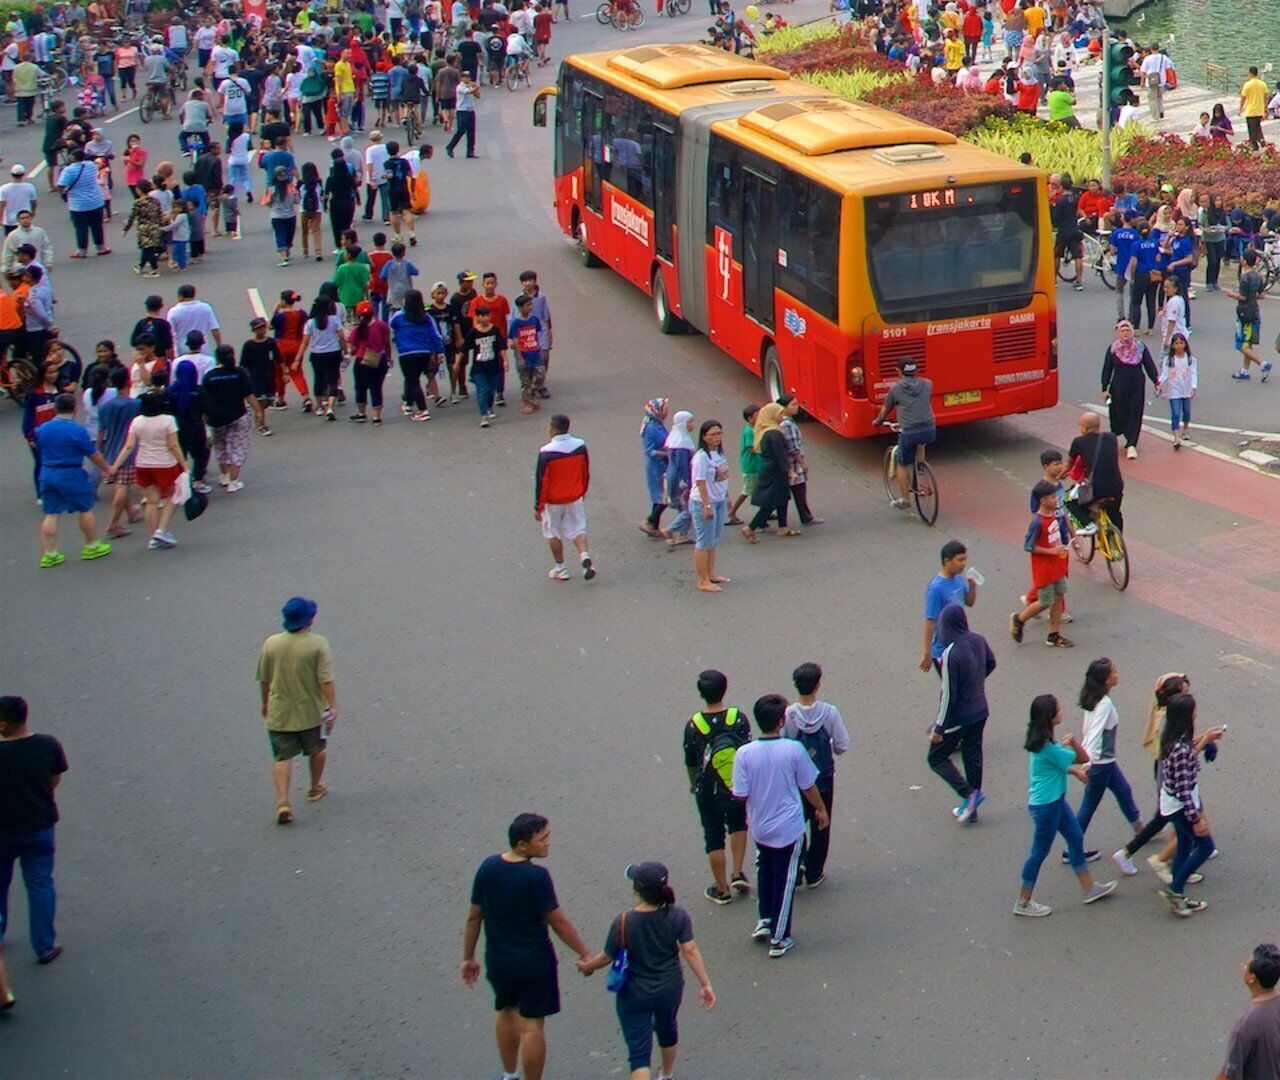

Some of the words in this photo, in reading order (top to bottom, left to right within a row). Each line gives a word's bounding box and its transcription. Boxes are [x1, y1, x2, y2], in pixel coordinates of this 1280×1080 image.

[611, 194, 649, 246] transjakarta
[1009, 312, 1036, 324] DAMRI
[882, 327, 908, 339] 5101
[926, 317, 992, 336] transjakarta
